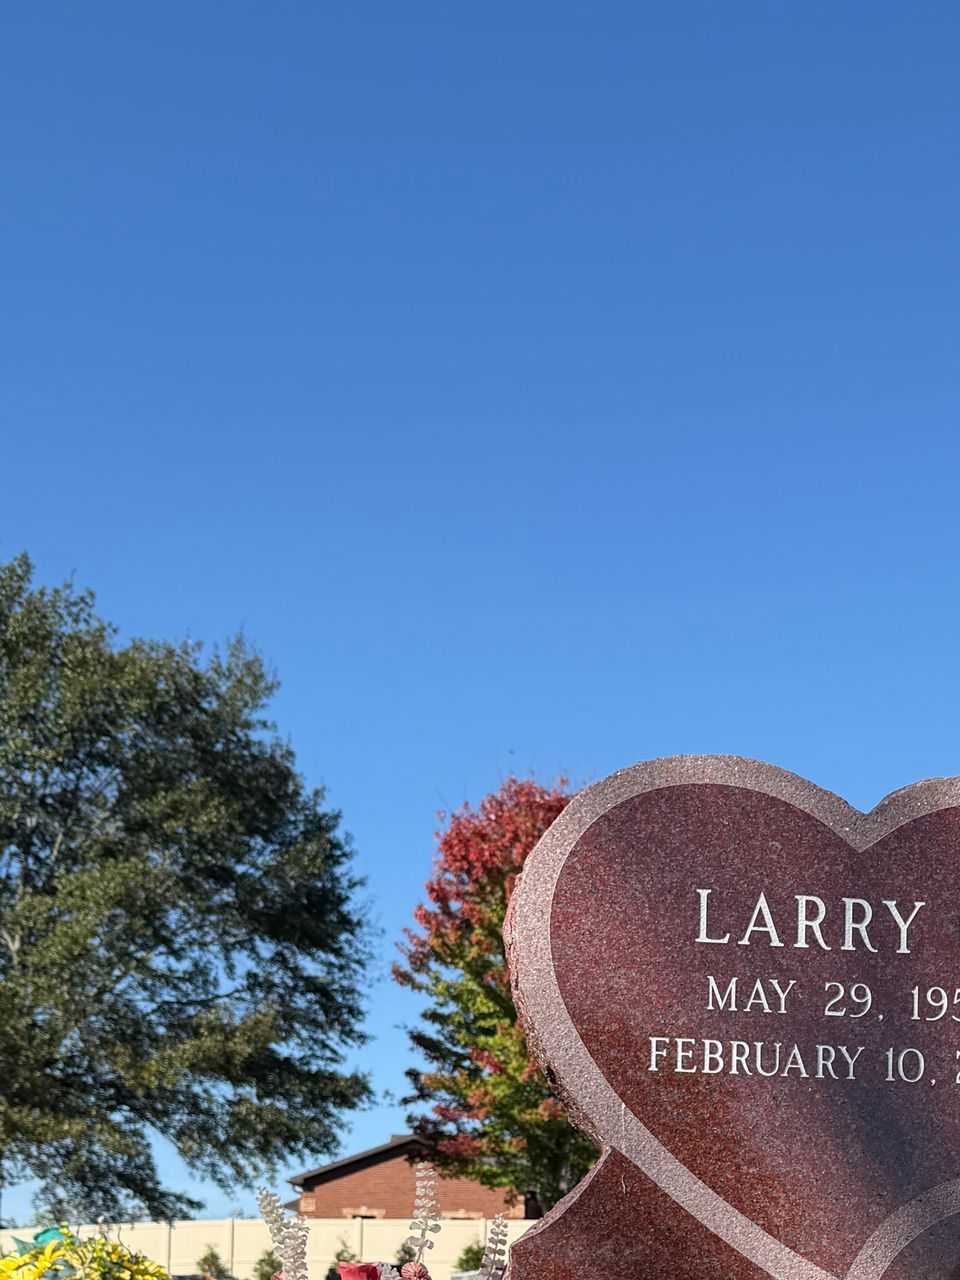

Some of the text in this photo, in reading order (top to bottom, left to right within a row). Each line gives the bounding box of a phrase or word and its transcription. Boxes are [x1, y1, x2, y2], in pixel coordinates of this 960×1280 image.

[695, 888, 925, 954] LARRY
[706, 976, 797, 1014] MAY
[824, 982, 883, 1022] 29,
[648, 1037, 865, 1080] FEBRUARY
[885, 1047, 936, 1086] 10,
